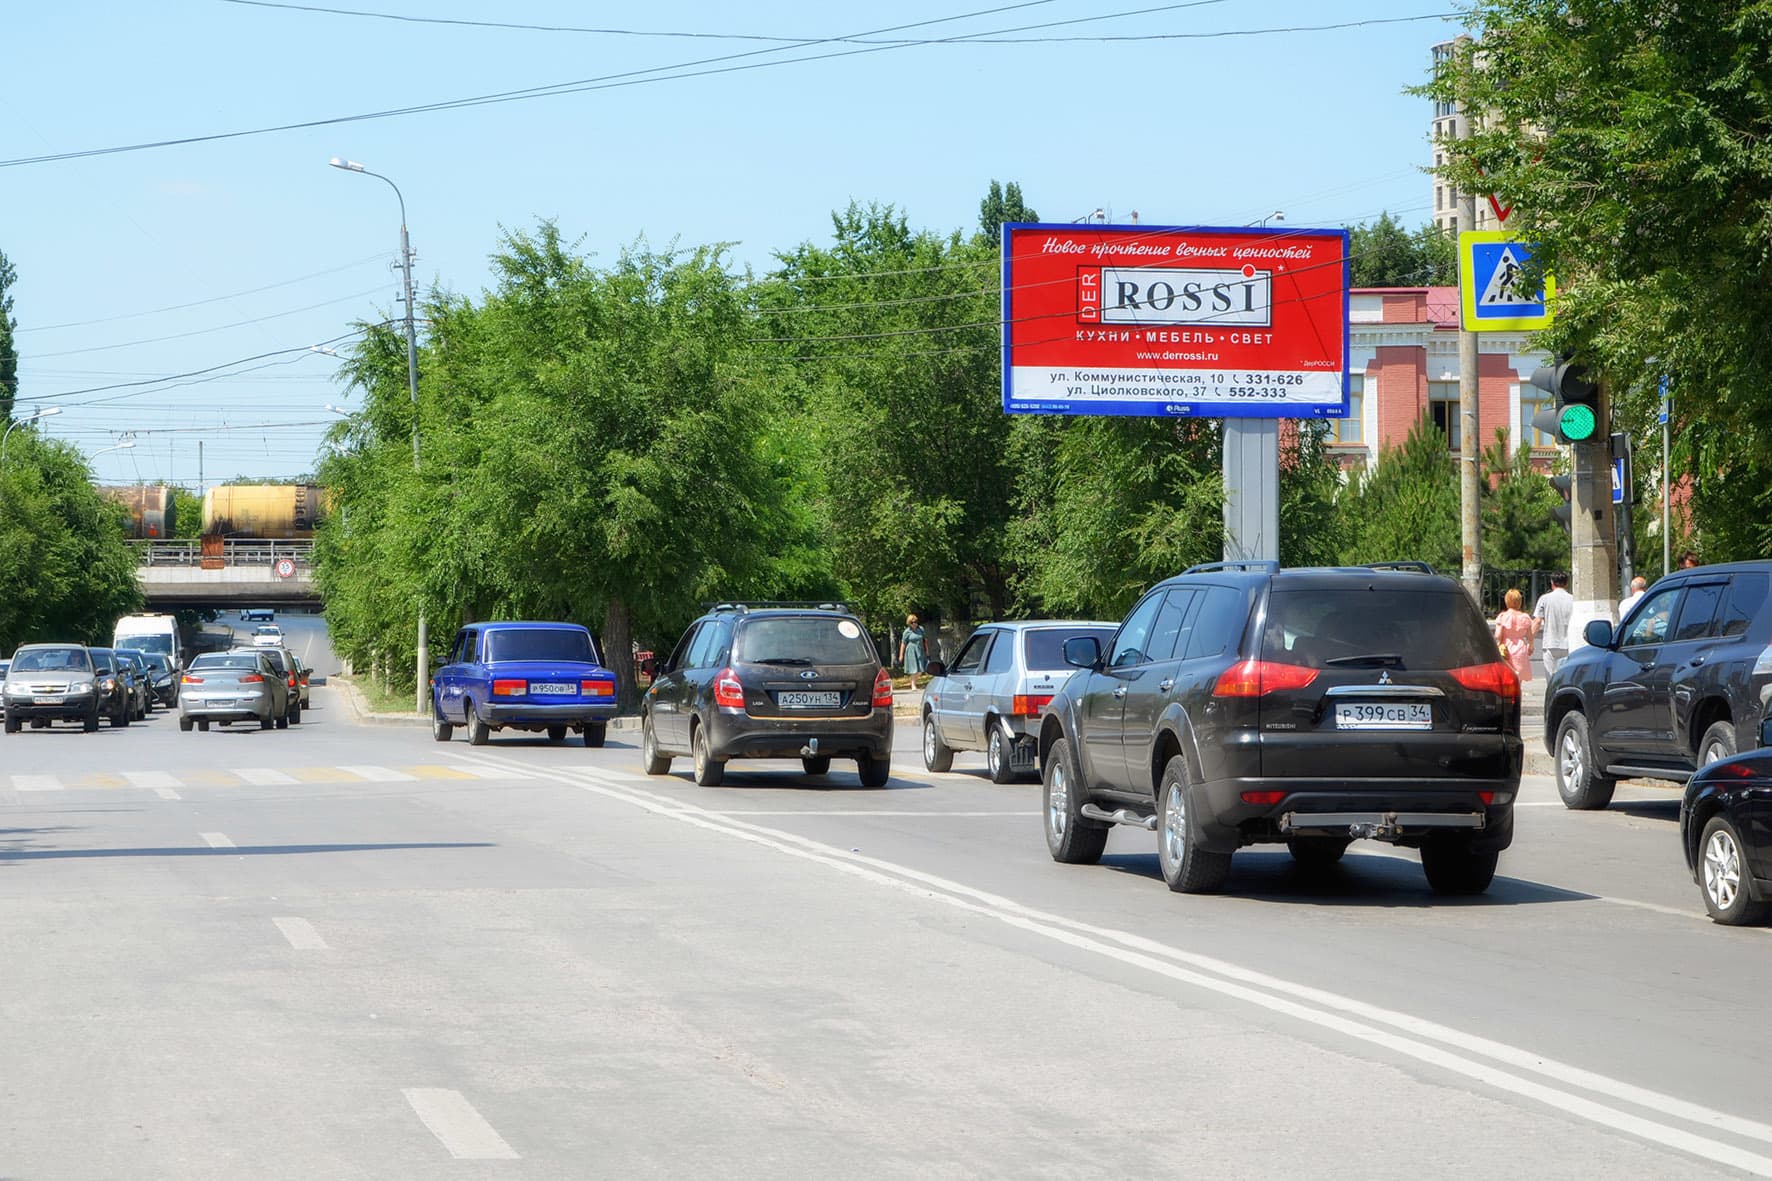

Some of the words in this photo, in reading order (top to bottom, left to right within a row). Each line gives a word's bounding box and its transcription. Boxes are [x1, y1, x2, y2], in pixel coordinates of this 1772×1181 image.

[1042, 237, 1087, 254] Новое
[1090, 242, 1171, 259] прочтение
[1175, 242, 1228, 257] вечных
[1232, 245, 1312, 260] ценностей
[1081, 273, 1096, 318] DER
[1115, 281, 1256, 312] ROSSI
[1075, 330, 1131, 342] КУХНИ
[1146, 331, 1214, 343] МЕБЕЛЬ
[1230, 333, 1274, 345] СВЕТ
[1136, 351, 1219, 361] www.derrossi.ru
[1050, 373, 1070, 384] ул.
[1074, 371, 1206, 385] Коммунистическая,
[1210, 373, 1225, 384] 10
[1246, 374, 1304, 385] 331-626
[1066, 386, 1087, 397] ул.
[1091, 385, 1189, 397] Циолковского,
[1192, 386, 1207, 397] 37
[1229, 387, 1287, 398] 552-333
